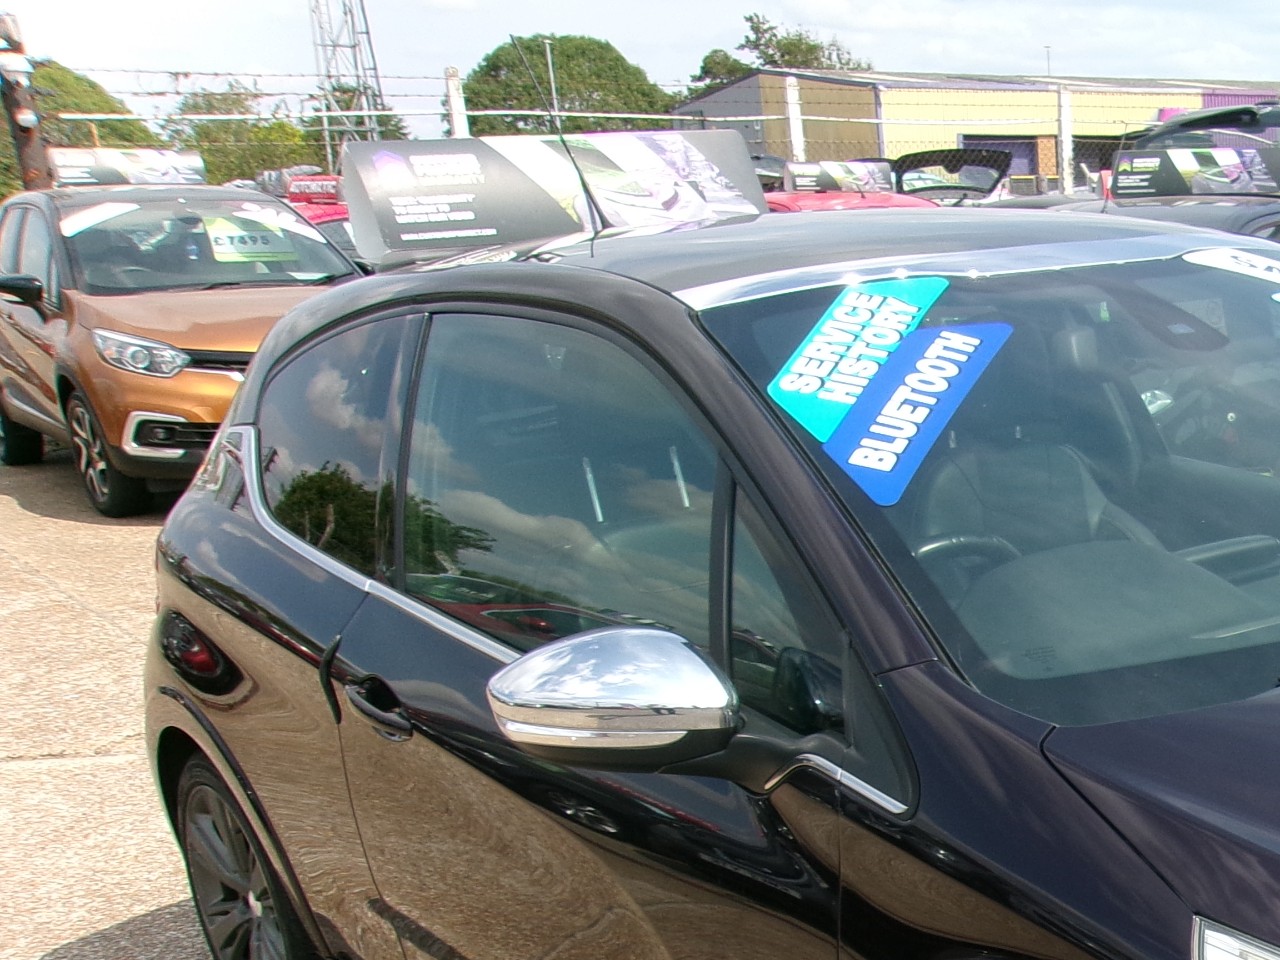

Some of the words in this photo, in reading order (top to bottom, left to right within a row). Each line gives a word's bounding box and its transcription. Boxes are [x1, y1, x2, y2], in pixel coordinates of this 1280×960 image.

[778, 291, 884, 395] SERVICE
[816, 296, 922, 406] HISTORY
[847, 329, 982, 473] BLUETOOTH
